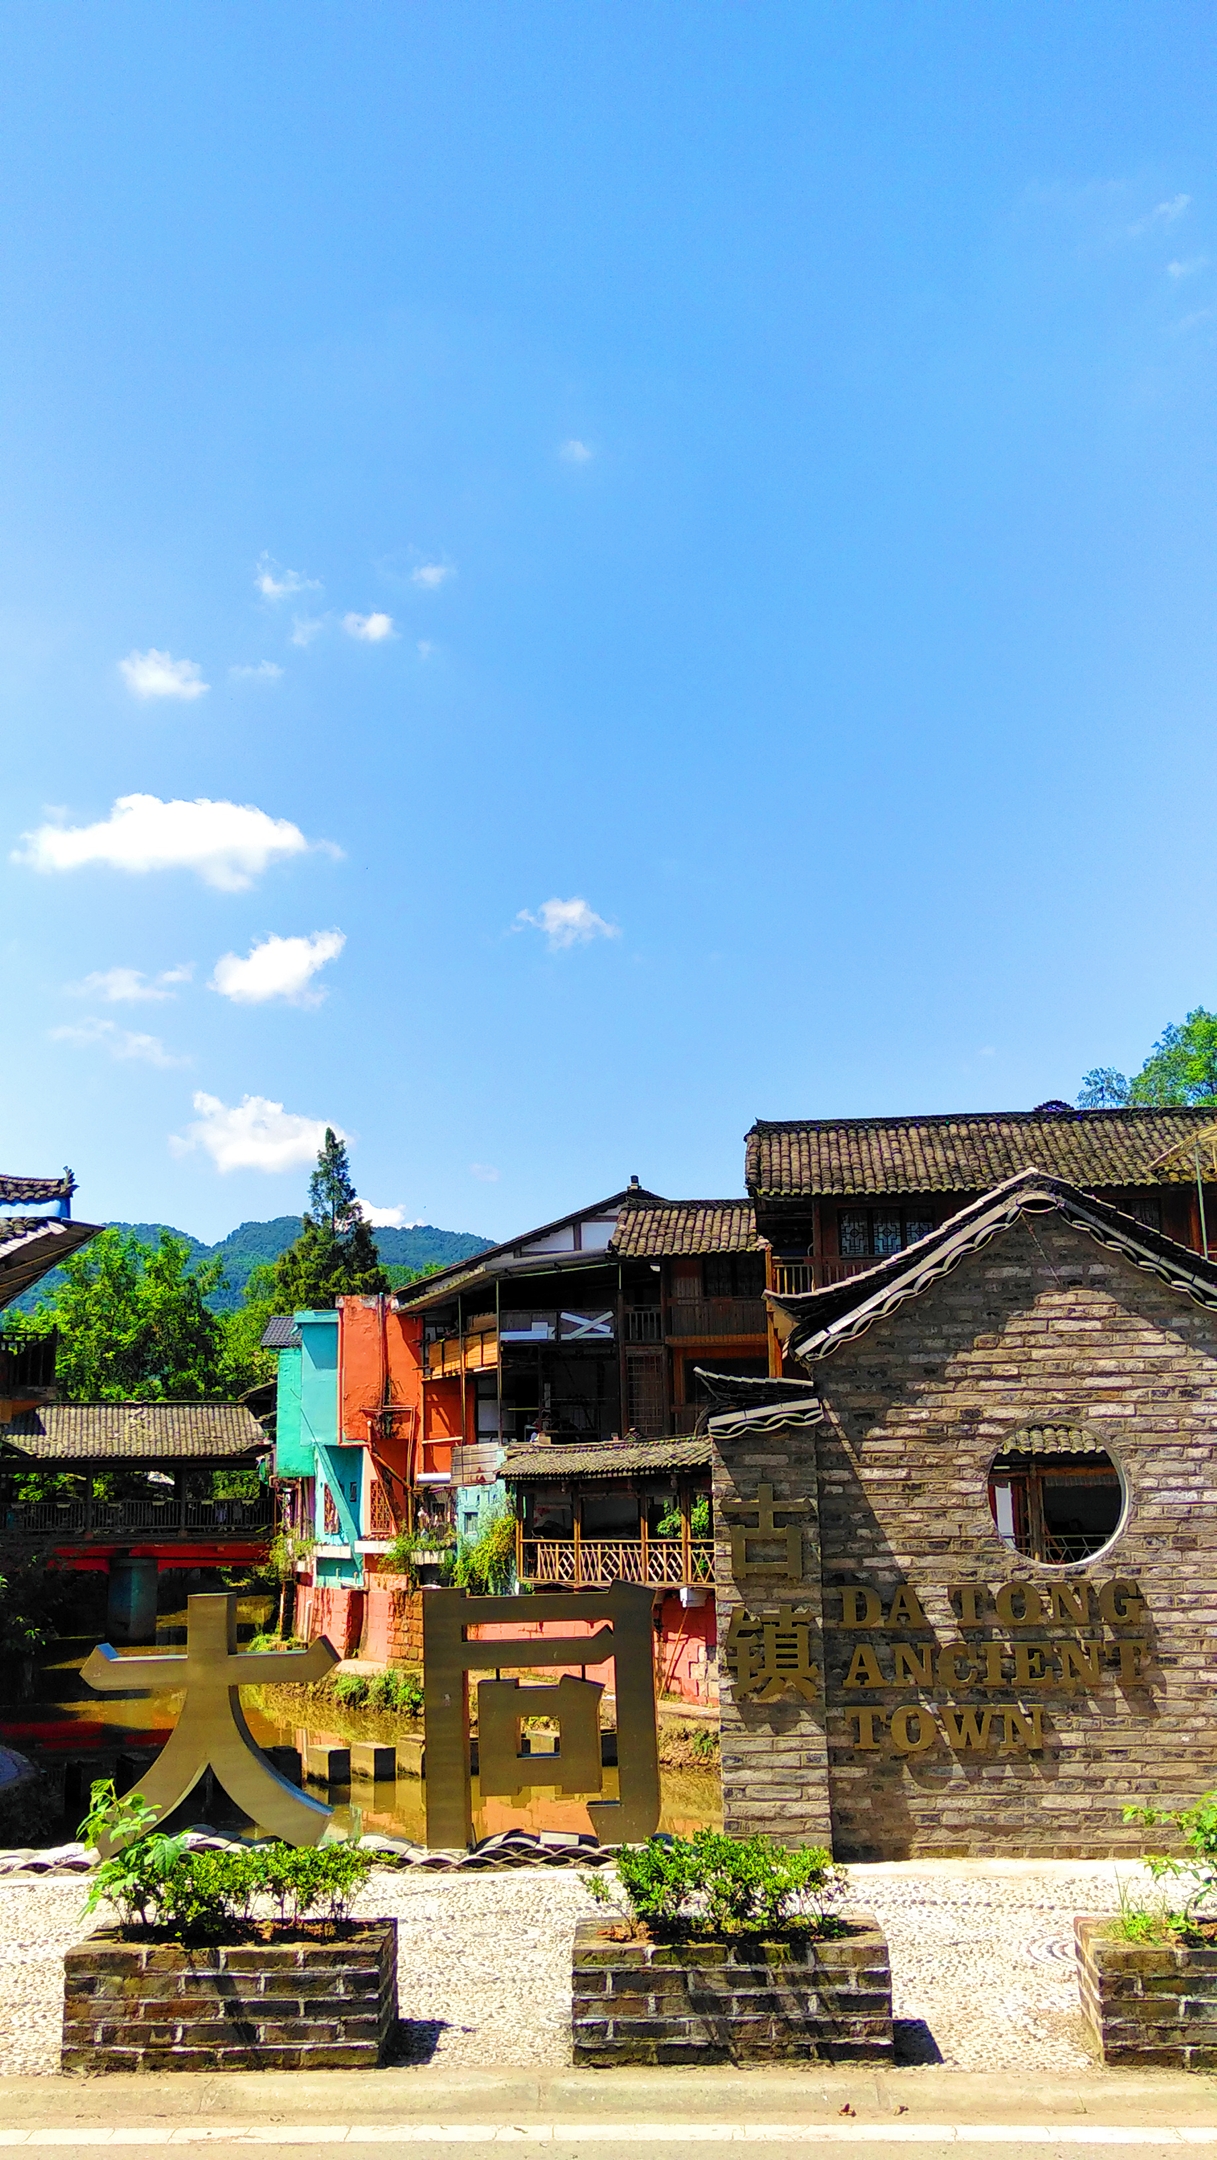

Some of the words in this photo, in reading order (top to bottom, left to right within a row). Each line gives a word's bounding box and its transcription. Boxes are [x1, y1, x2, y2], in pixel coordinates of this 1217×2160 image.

[721, 1483, 820, 1700] 古镇
[81, 1580, 657, 1855] 大同
[842, 1640, 1149, 1689] ANCIENT
[846, 1705, 1045, 1751] TOWN
